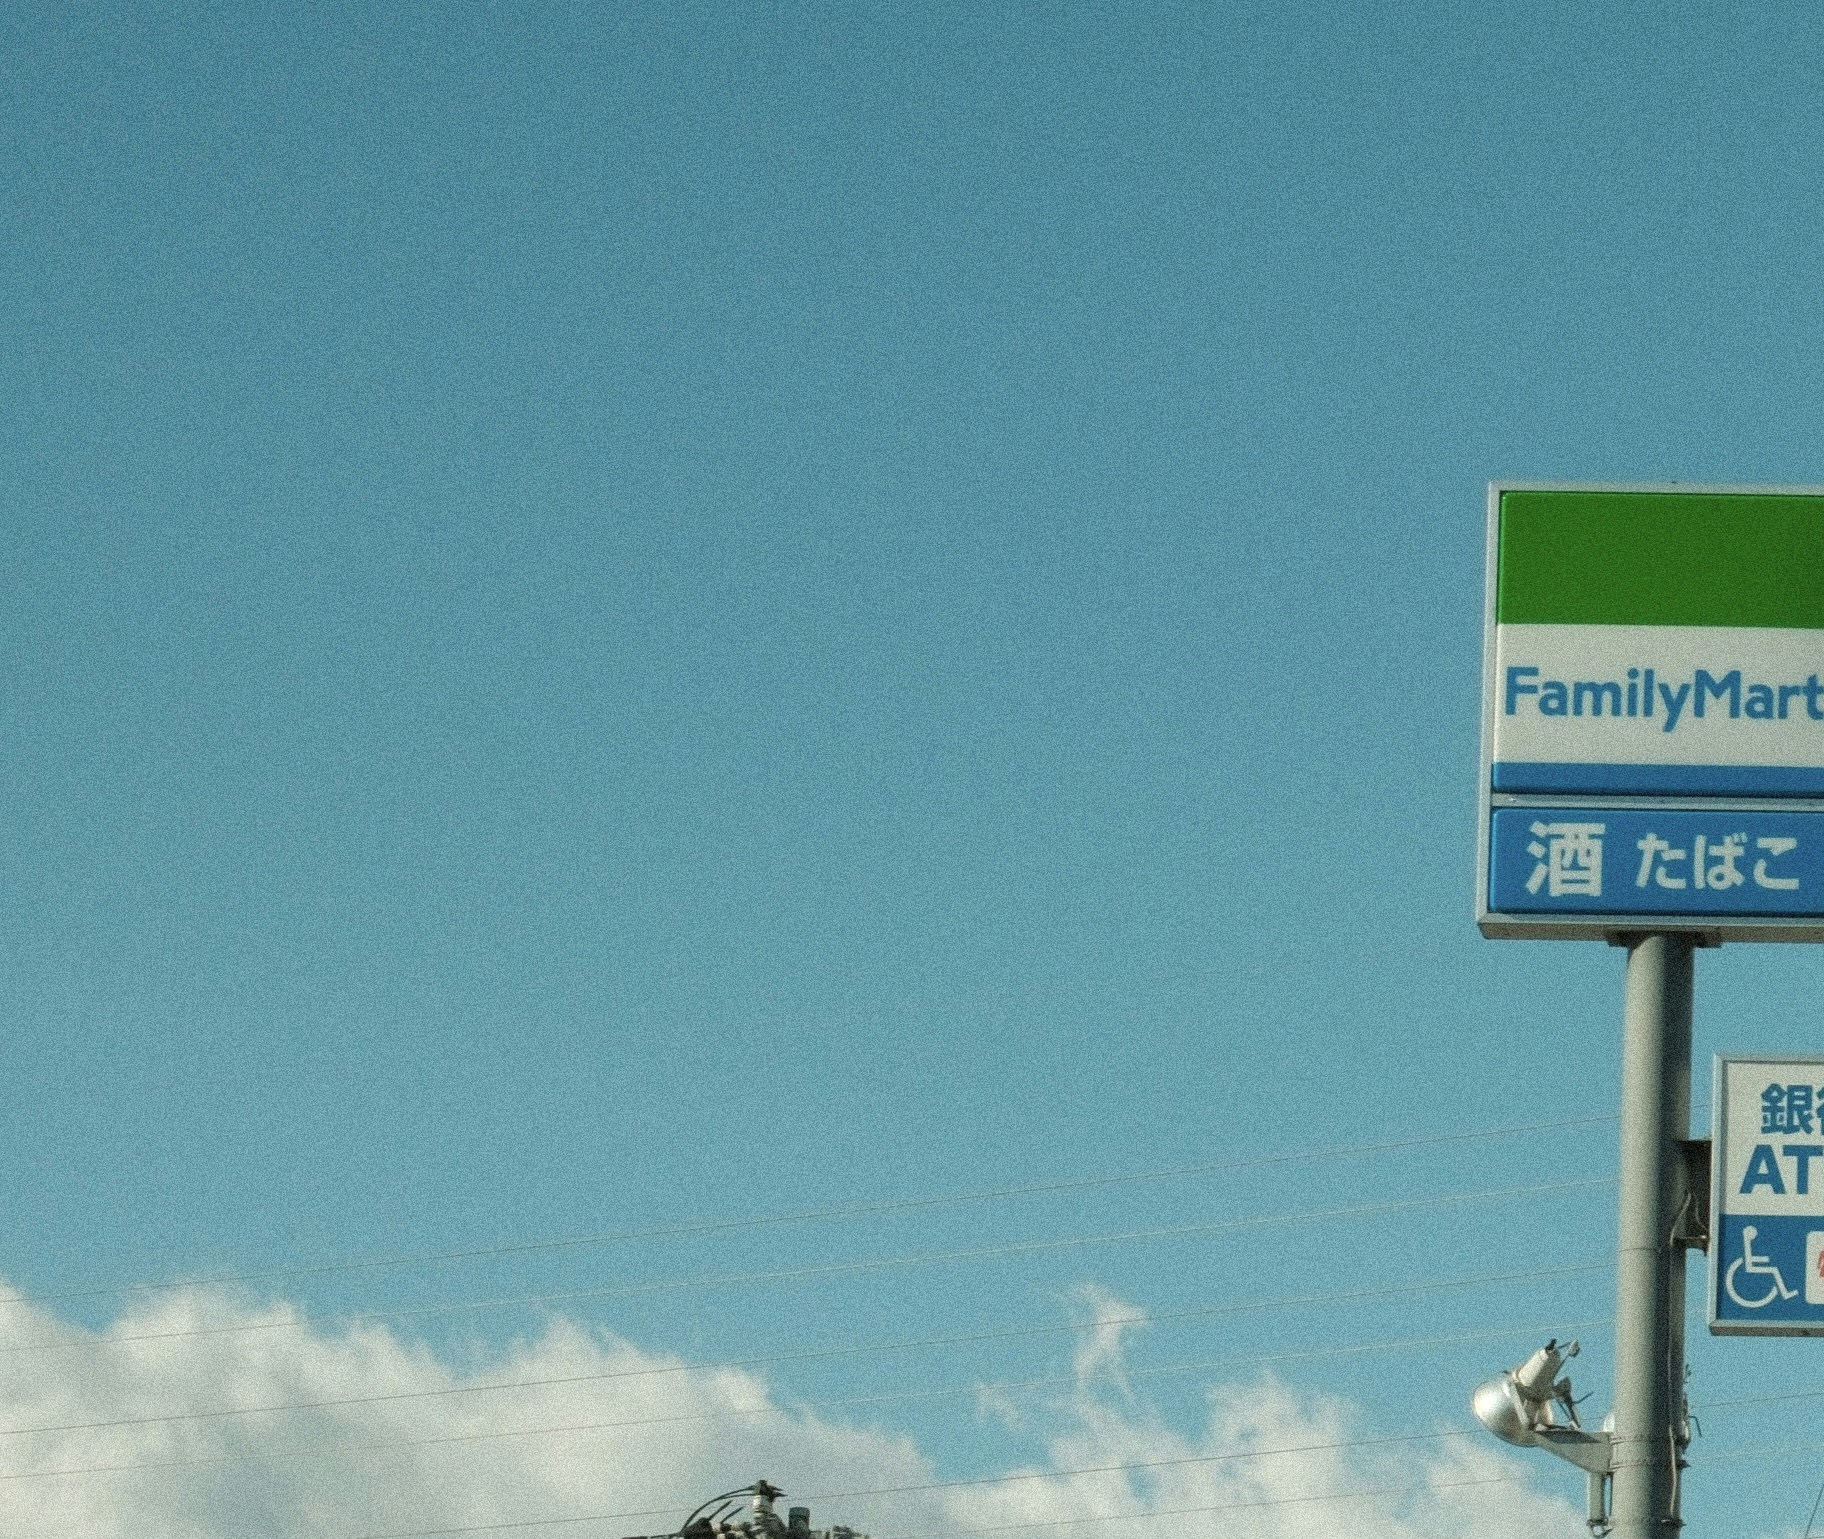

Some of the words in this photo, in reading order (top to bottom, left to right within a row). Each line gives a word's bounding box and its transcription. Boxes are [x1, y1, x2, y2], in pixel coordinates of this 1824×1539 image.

[1525, 821, 1604, 898] 酒
[1635, 831, 1800, 890] たばこ
